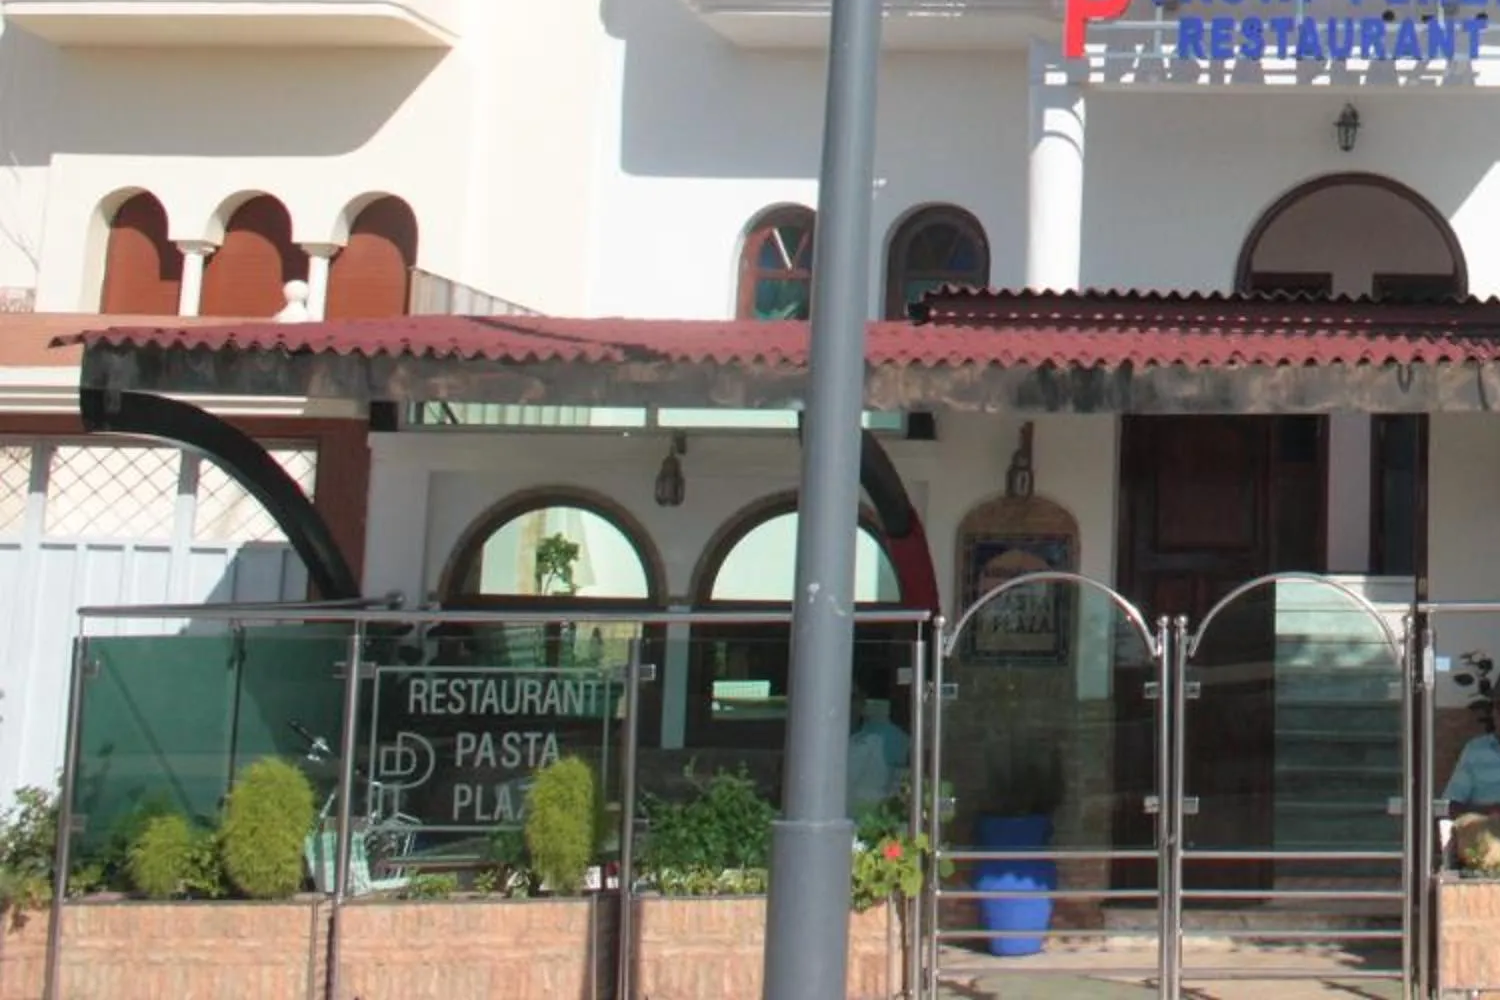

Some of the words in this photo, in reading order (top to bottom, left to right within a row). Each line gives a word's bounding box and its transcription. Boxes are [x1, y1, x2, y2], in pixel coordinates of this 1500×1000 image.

[1177, 16, 1489, 61] RESTAURANT
[407, 678, 602, 716] RESTAURANT
[454, 730, 561, 768] PASTA
